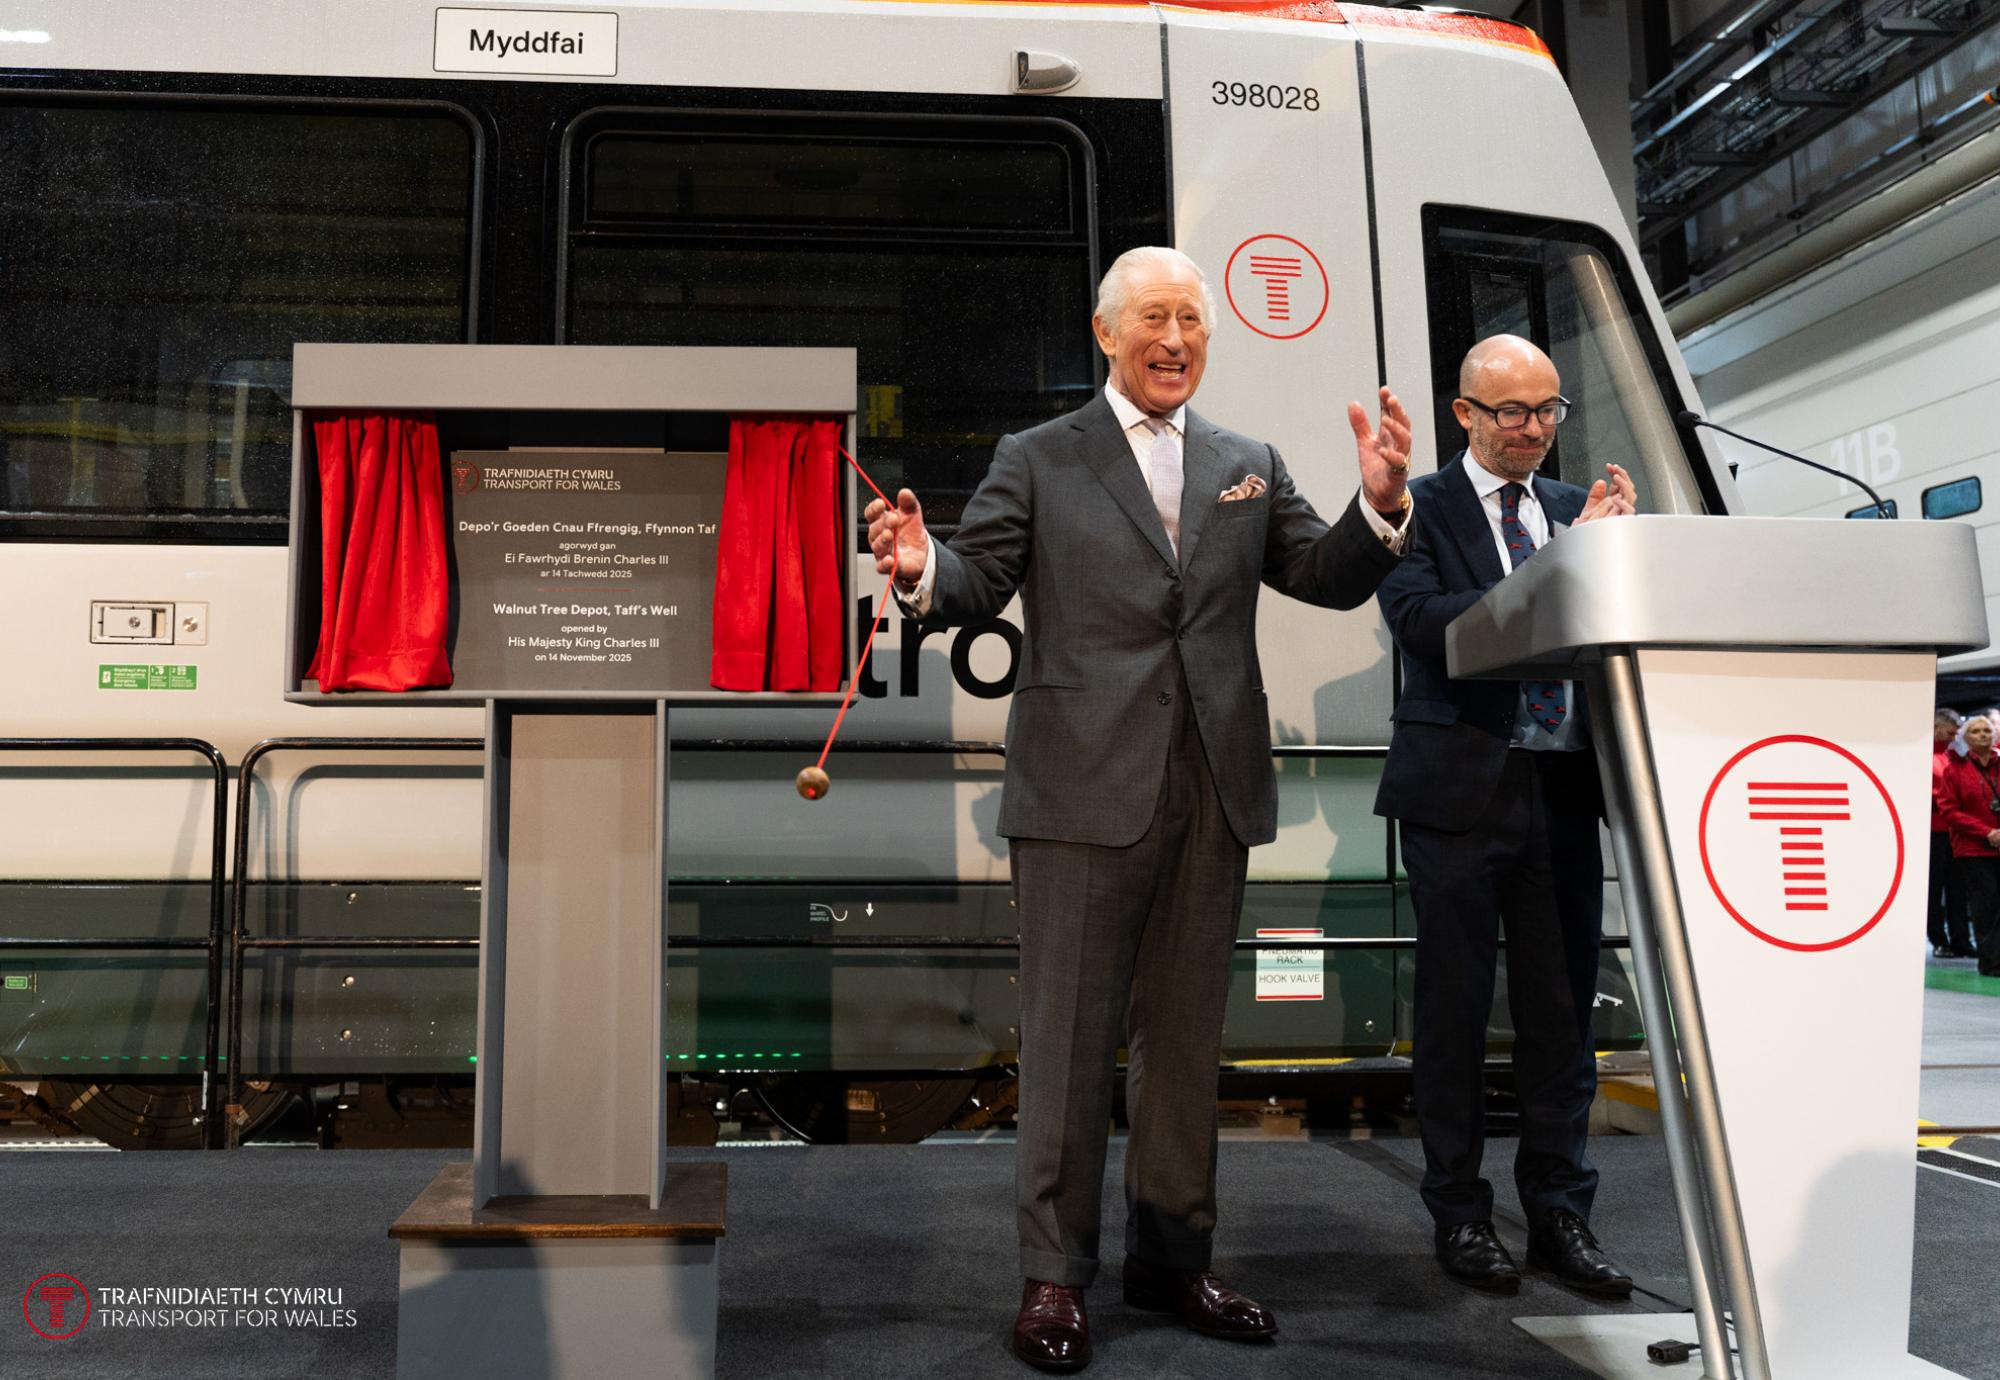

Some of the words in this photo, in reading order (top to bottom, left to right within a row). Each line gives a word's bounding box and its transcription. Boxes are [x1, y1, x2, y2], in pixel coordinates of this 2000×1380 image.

[469, 28, 584, 58] Myddfai
[1211, 80, 1320, 111] 398028
[1830, 421, 1902, 497] 11B
[484, 467, 569, 480] TRAFNIDIAETH
[571, 468, 614, 480] CYMRU
[483, 479, 554, 490] TRANSPORT
[555, 480, 580, 490] FOR
[581, 481, 622, 491] WALES
[459, 521, 500, 534] Depo'r
[502, 521, 550, 532] Goeden
[552, 522, 584, 533] Cnau
[587, 522, 642, 536] Ffrengig,
[645, 523, 695, 536] Ffynnon
[697, 524, 717, 534] Taf
[559, 542, 598, 551] agorwyd
[599, 543, 617, 552] gan
[504, 552, 516, 563] Ei
[518, 553, 571, 566] Fawrhydi
[573, 554, 611, 565] Brenin
[613, 554, 657, 565] Charles
[658, 555, 669, 565] III
[540, 570, 551, 578] ar
[552, 570, 562, 578] 14
[563, 569, 608, 579] Tachwedd
[609, 570, 633, 579] 2025
[493, 603, 538, 615] Walnut
[540, 604, 569, 615] Tree
[570, 604, 612, 618] Depot,
[650, 605, 678, 616] Well
[561, 625, 596, 634] opened
[596, 625, 608, 635] by
[508, 636, 527, 648] His
[528, 637, 573, 650] Majesty
[575, 637, 602, 650] King
[603, 637, 648, 648] Charles
[649, 638, 660, 648] III
[534, 654, 547, 662] on
[548, 653, 558, 661] 14
[560, 653, 607, 662] November
[608, 653, 633, 662] 2025
[1276, 955, 1305, 965] RACK
[1258, 974, 1288, 984] HOOK
[1289, 974, 1321, 984] VALVE
